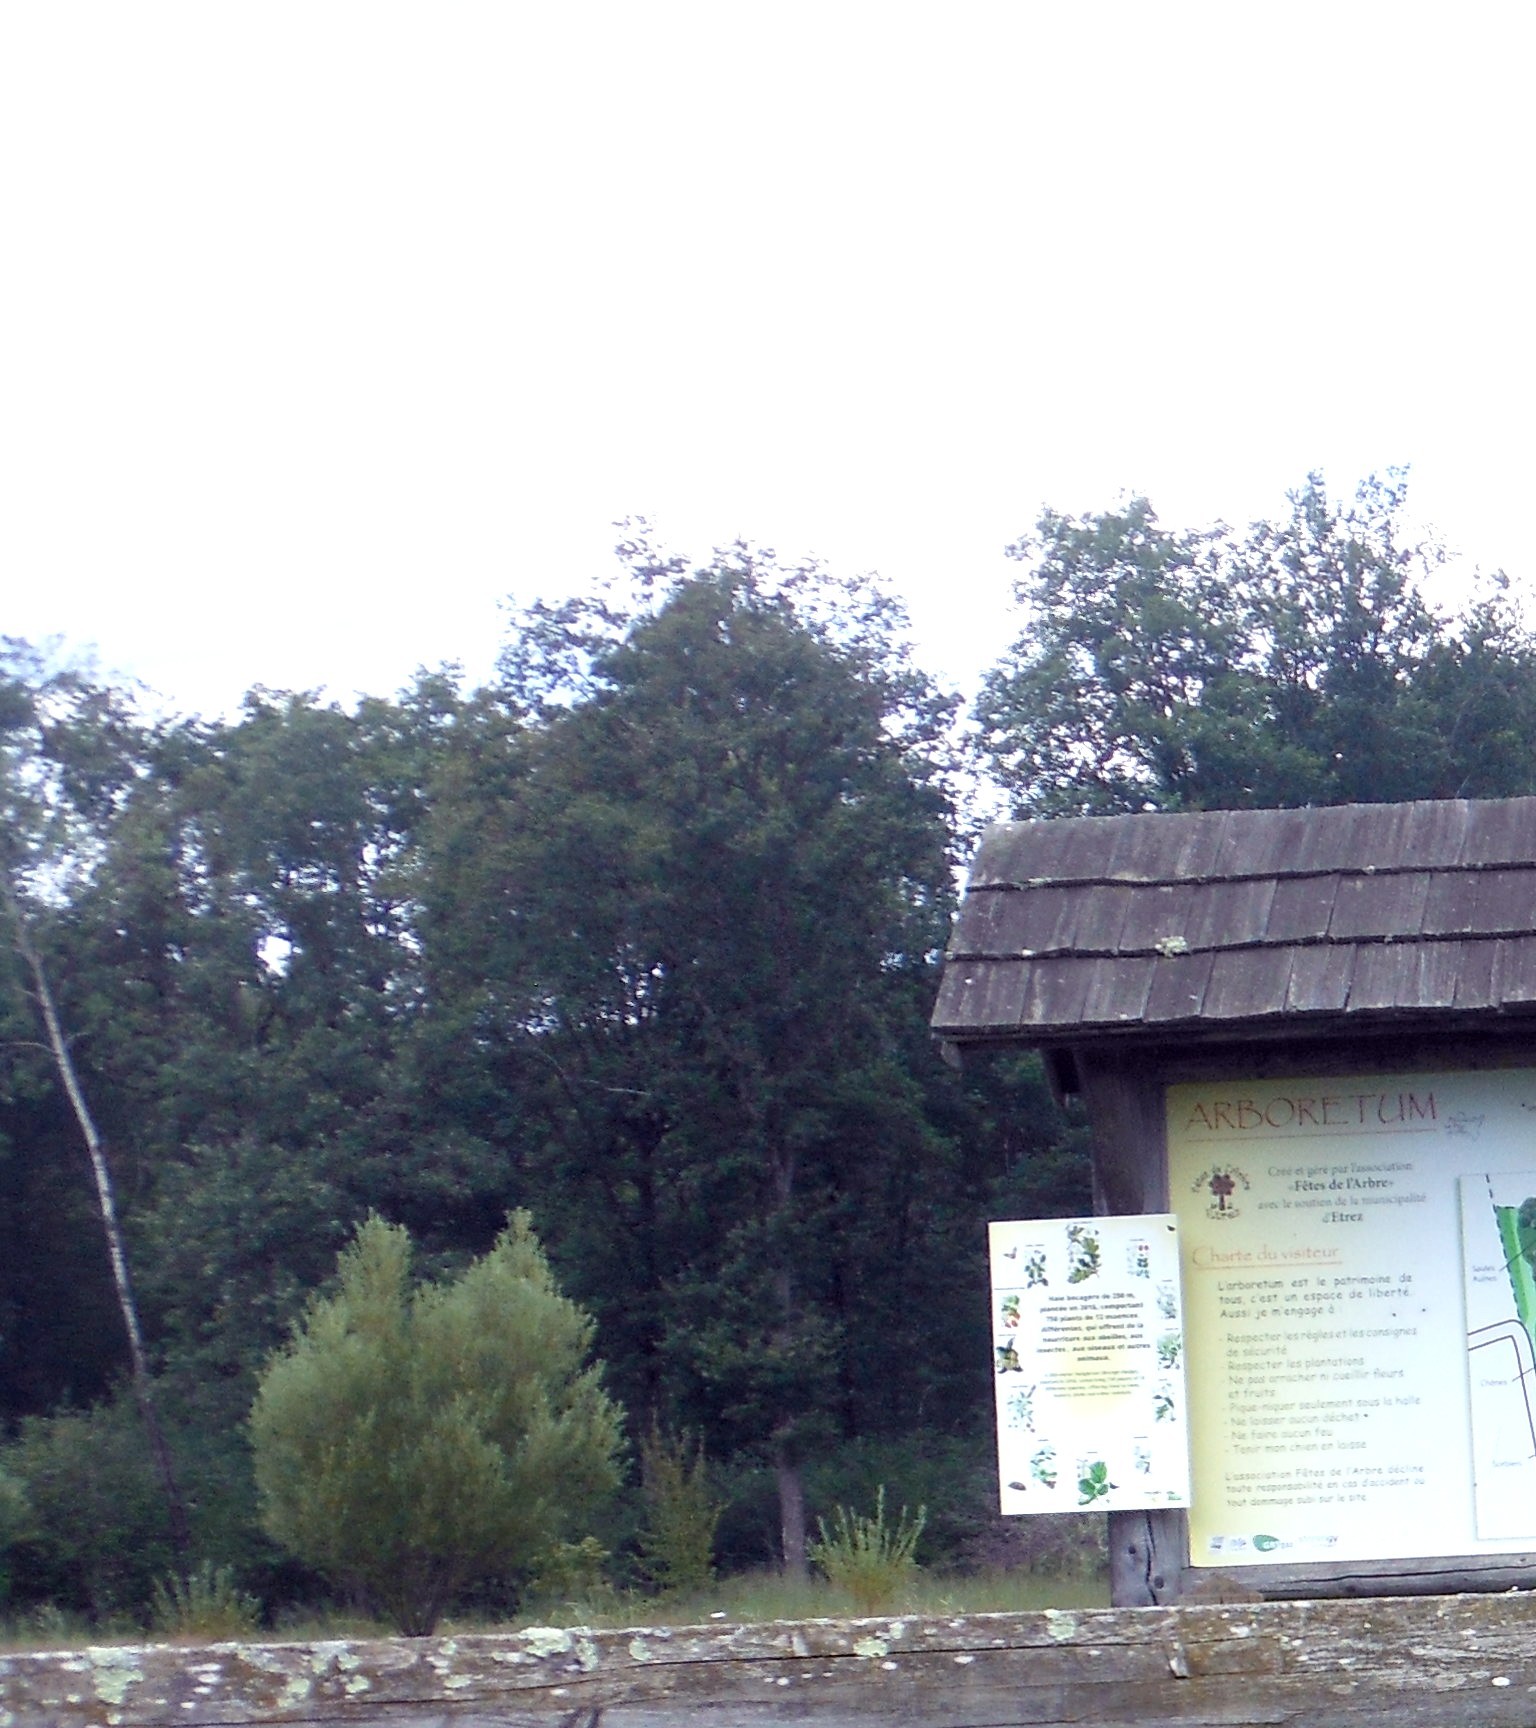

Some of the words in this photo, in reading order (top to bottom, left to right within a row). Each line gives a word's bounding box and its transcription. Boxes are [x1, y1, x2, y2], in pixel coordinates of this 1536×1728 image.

[1184, 1092, 1437, 1131] ARBORETUM
[1331, 1164, 1347, 1176] par
[1351, 1160, 1413, 1173] l'association
[1329, 1178, 1342, 1190] de
[1257, 1200, 1278, 1211] avec
[1282, 1197, 1293, 1210] le
[1294, 1196, 1330, 1209] soutien
[1334, 1195, 1346, 1207] de
[1350, 1195, 1359, 1206] la
[1362, 1192, 1426, 1207] municipalité
[1191, 1246, 1252, 1266] Charte
[1257, 1243, 1277, 1261] du
[1281, 1246, 1339, 1260] visiteur
[1218, 1278, 1284, 1291] L'arboretum
[1291, 1278, 1308, 1288] est
[1316, 1275, 1326, 1286] le
[1334, 1274, 1391, 1287] patrimoine
[1399, 1273, 1412, 1283] de
[1250, 1294, 1278, 1304] c'est
[1284, 1294, 1298, 1302] un
[1304, 1291, 1343, 1303] espace
[1349, 1289, 1362, 1299] de
[1220, 1308, 1250, 1319] Aussi
[1255, 1308, 1267, 1320] je
[1271, 1306, 1324, 1319] m'engage
[1226, 1333, 1281, 1345] Respecter
[1284, 1331, 1299, 1341] les
[1301, 1331, 1334, 1343] règles
[1336, 1330, 1347, 1339] et
[1349, 1329, 1365, 1338] les
[1366, 1327, 1417, 1339] consignes
[1226, 1348, 1239, 1357] de
[1243, 1346, 1287, 1357] sécurité
[1228, 1360, 1283, 1372] Respecter
[1286, 1359, 1302, 1369] les
[1305, 1357, 1364, 1369] plantations
[1229, 1375, 1244, 1385] Ne
[1247, 1375, 1265, 1385] pas
[1269, 1373, 1316, 1384] arracher
[1320, 1372, 1329, 1381] ni
[1373, 1368, 1404, 1379] fleurs
[1228, 1389, 1239, 1399] et
[1244, 1388, 1275, 1398] fruits
[1299, 1398, 1353, 1410] seulement
[1356, 1398, 1380, 1408] sous
[1383, 1396, 1393, 1406] la
[1395, 1395, 1421, 1406] halle
[1230, 1416, 1246, 1426] Ne
[1250, 1416, 1286, 1426] laisser
[1289, 1415, 1319, 1424] aucun
[1322, 1412, 1360, 1423] déchet
[1231, 1431, 1247, 1440] Ne
[1251, 1429, 1278, 1440] faire
[1280, 1429, 1311, 1439] aucun
[1314, 1427, 1333, 1437] feu
[1233, 1443, 1261, 1454] Tenir
[1265, 1443, 1287, 1453] mon
[1290, 1442, 1319, 1452] chien
[1321, 1442, 1334, 1451] en
[1337, 1440, 1367, 1450] laisse
[1225, 1470, 1292, 1482] L'association
[1296, 1467, 1325, 1479] Fêtes
[1329, 1468, 1342, 1477] de
[1387, 1464, 1424, 1475] décline
[1226, 1484, 1252, 1494] toute
[1327, 1481, 1338, 1489] en
[1342, 1479, 1358, 1489] cas
